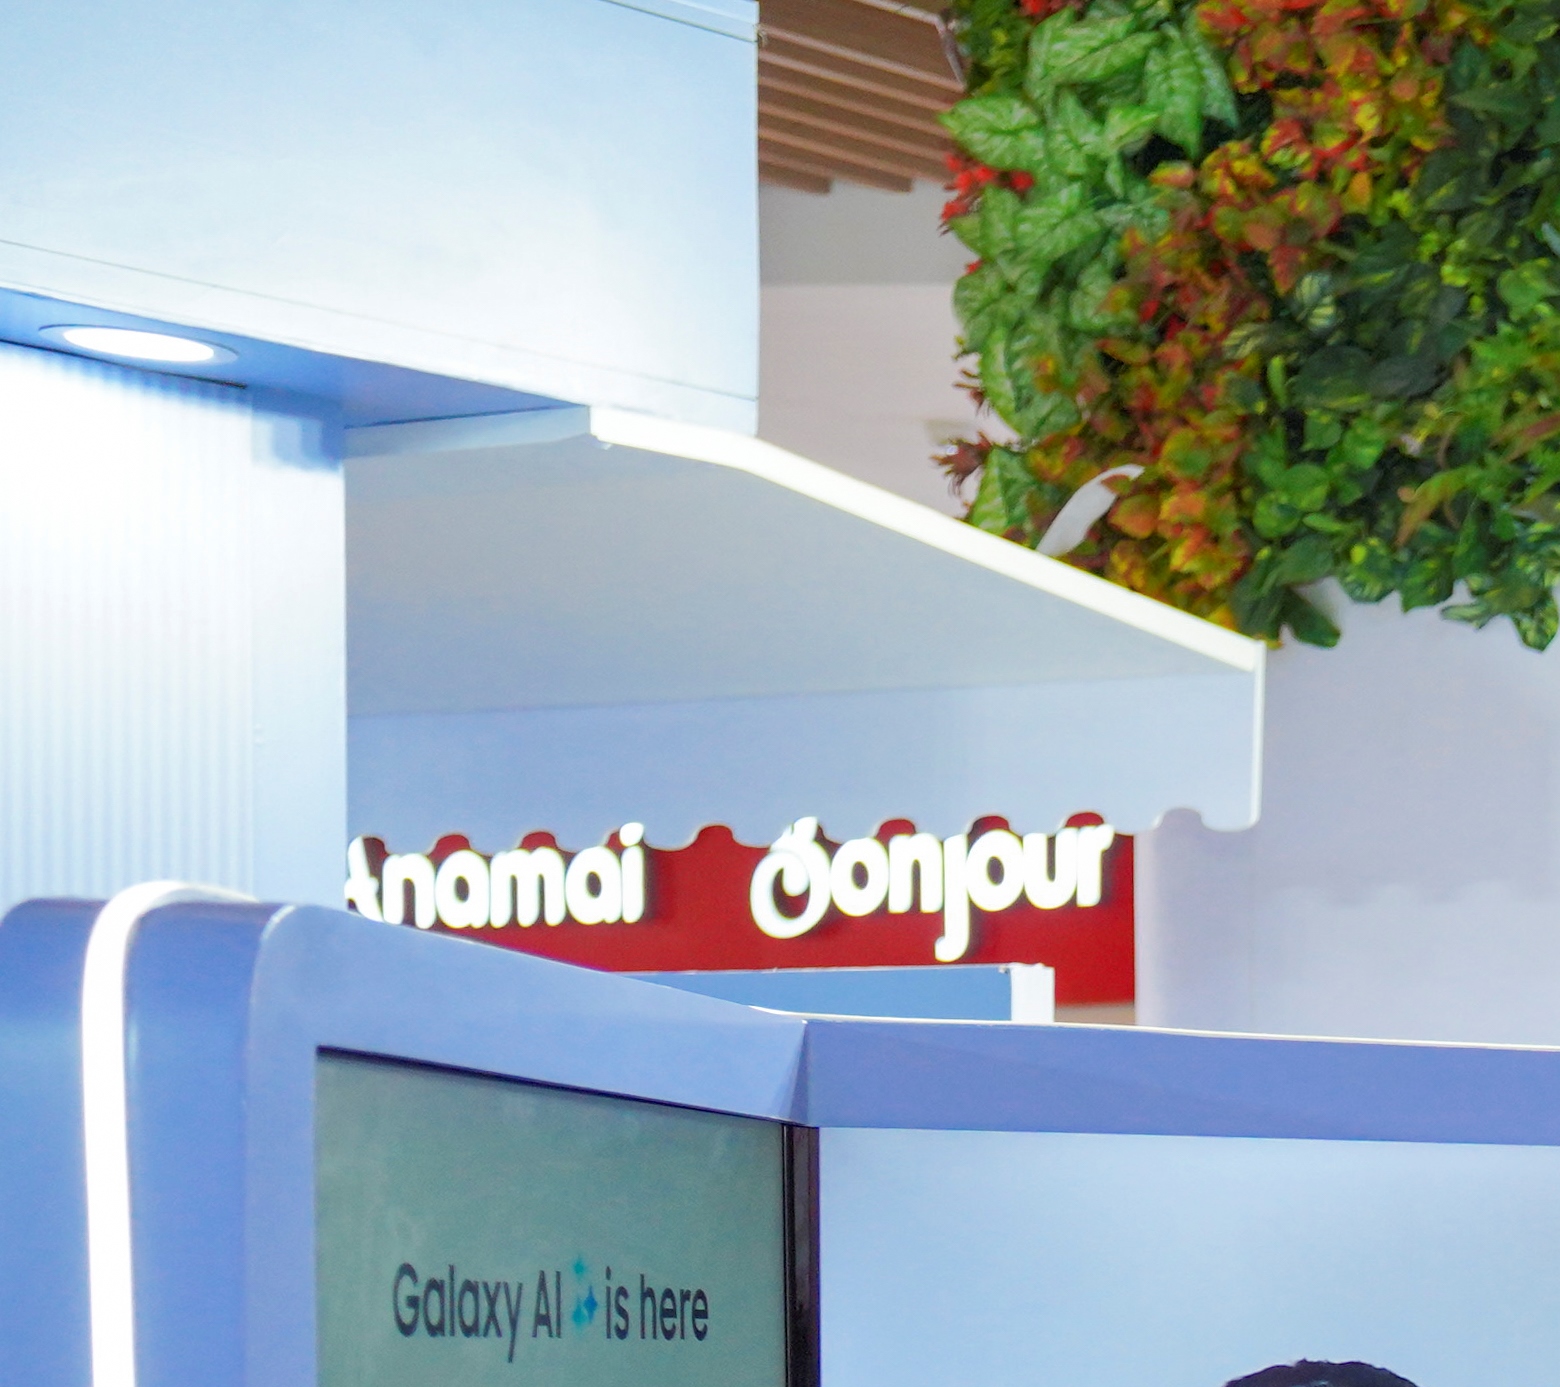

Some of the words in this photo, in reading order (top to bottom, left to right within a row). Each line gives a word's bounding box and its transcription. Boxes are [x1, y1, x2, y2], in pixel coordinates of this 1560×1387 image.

[750, 816, 1114, 963] Bonjour
[393, 1262, 523, 1363] Galaxy
[532, 1269, 562, 1339] AI
[605, 1265, 629, 1341] is
[639, 1273, 709, 1342] here
